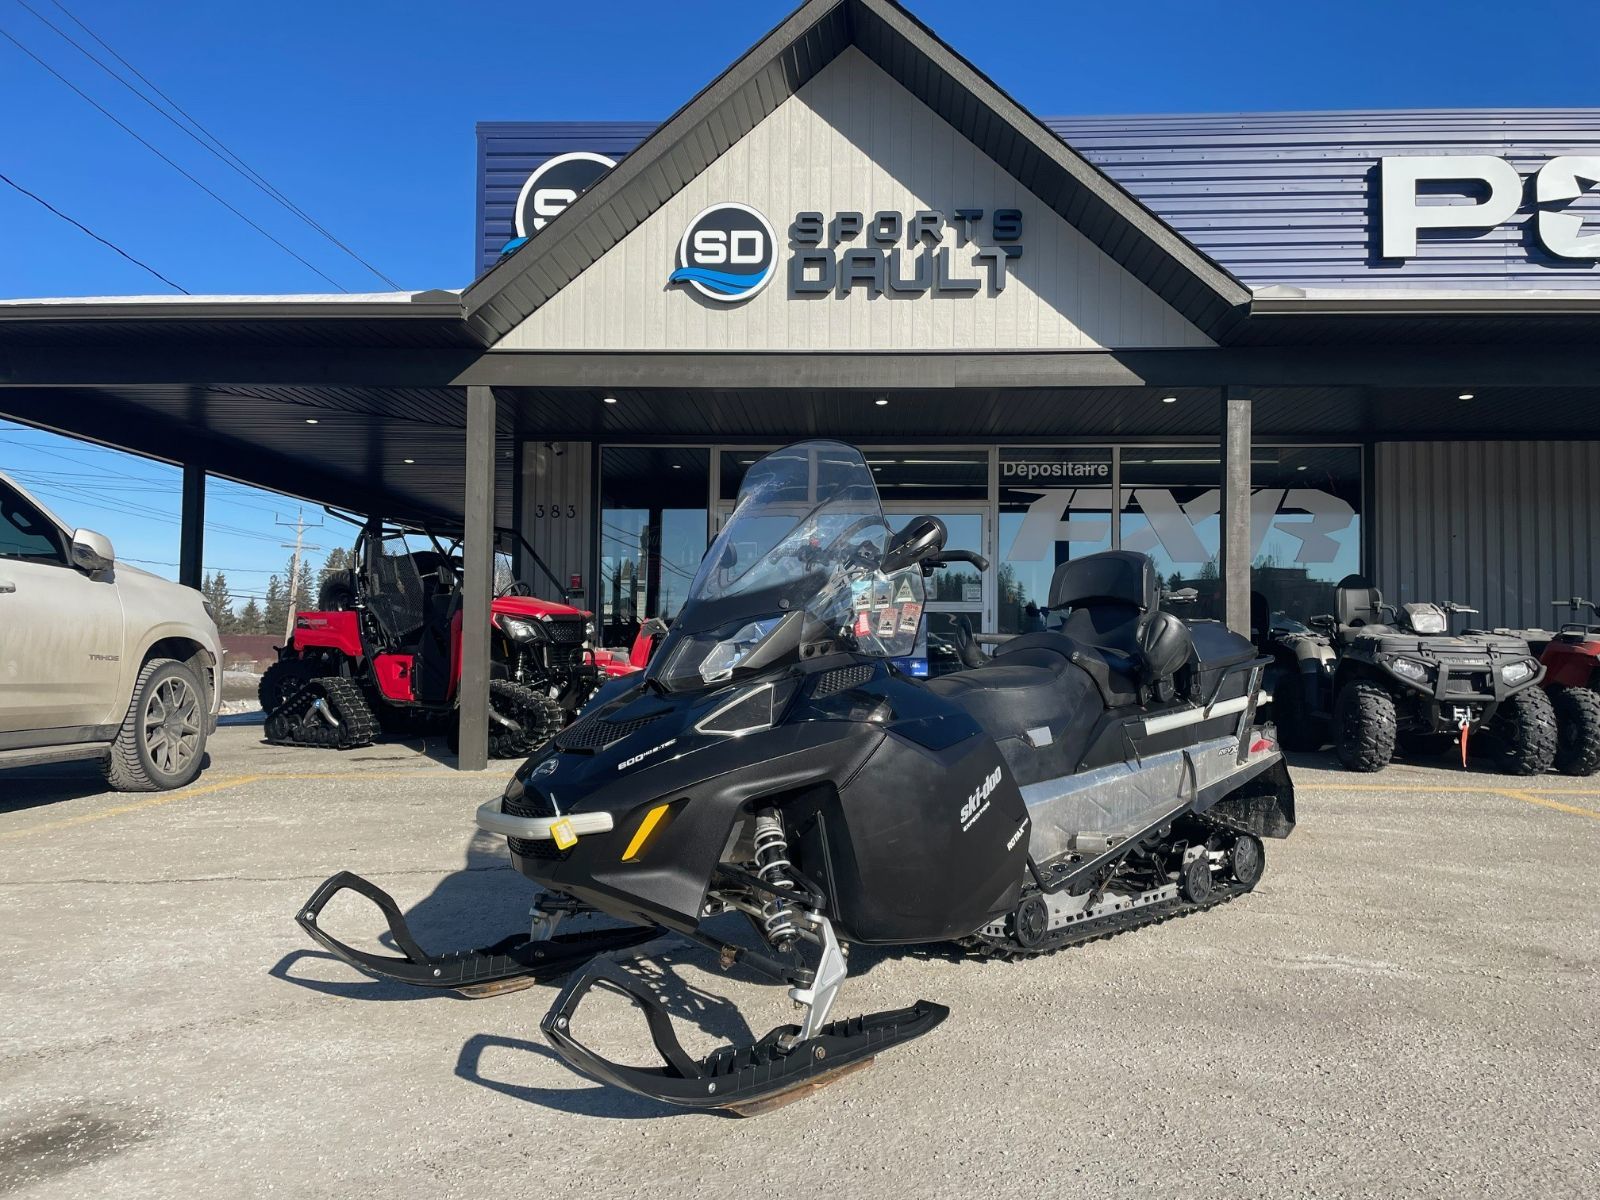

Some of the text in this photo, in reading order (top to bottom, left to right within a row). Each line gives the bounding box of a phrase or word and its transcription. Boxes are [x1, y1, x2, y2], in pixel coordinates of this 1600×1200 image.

[793, 209, 1023, 244] SPORTS
[694, 230, 764, 264] SD
[794, 246, 1023, 294] DAULT
[1003, 461, 1109, 480] Dépositaire
[535, 504, 576, 519] 383
[1007, 488, 1356, 563] FXR
[88, 653, 120, 662] TAHOE
[960, 765, 1002, 824] ski-doo
